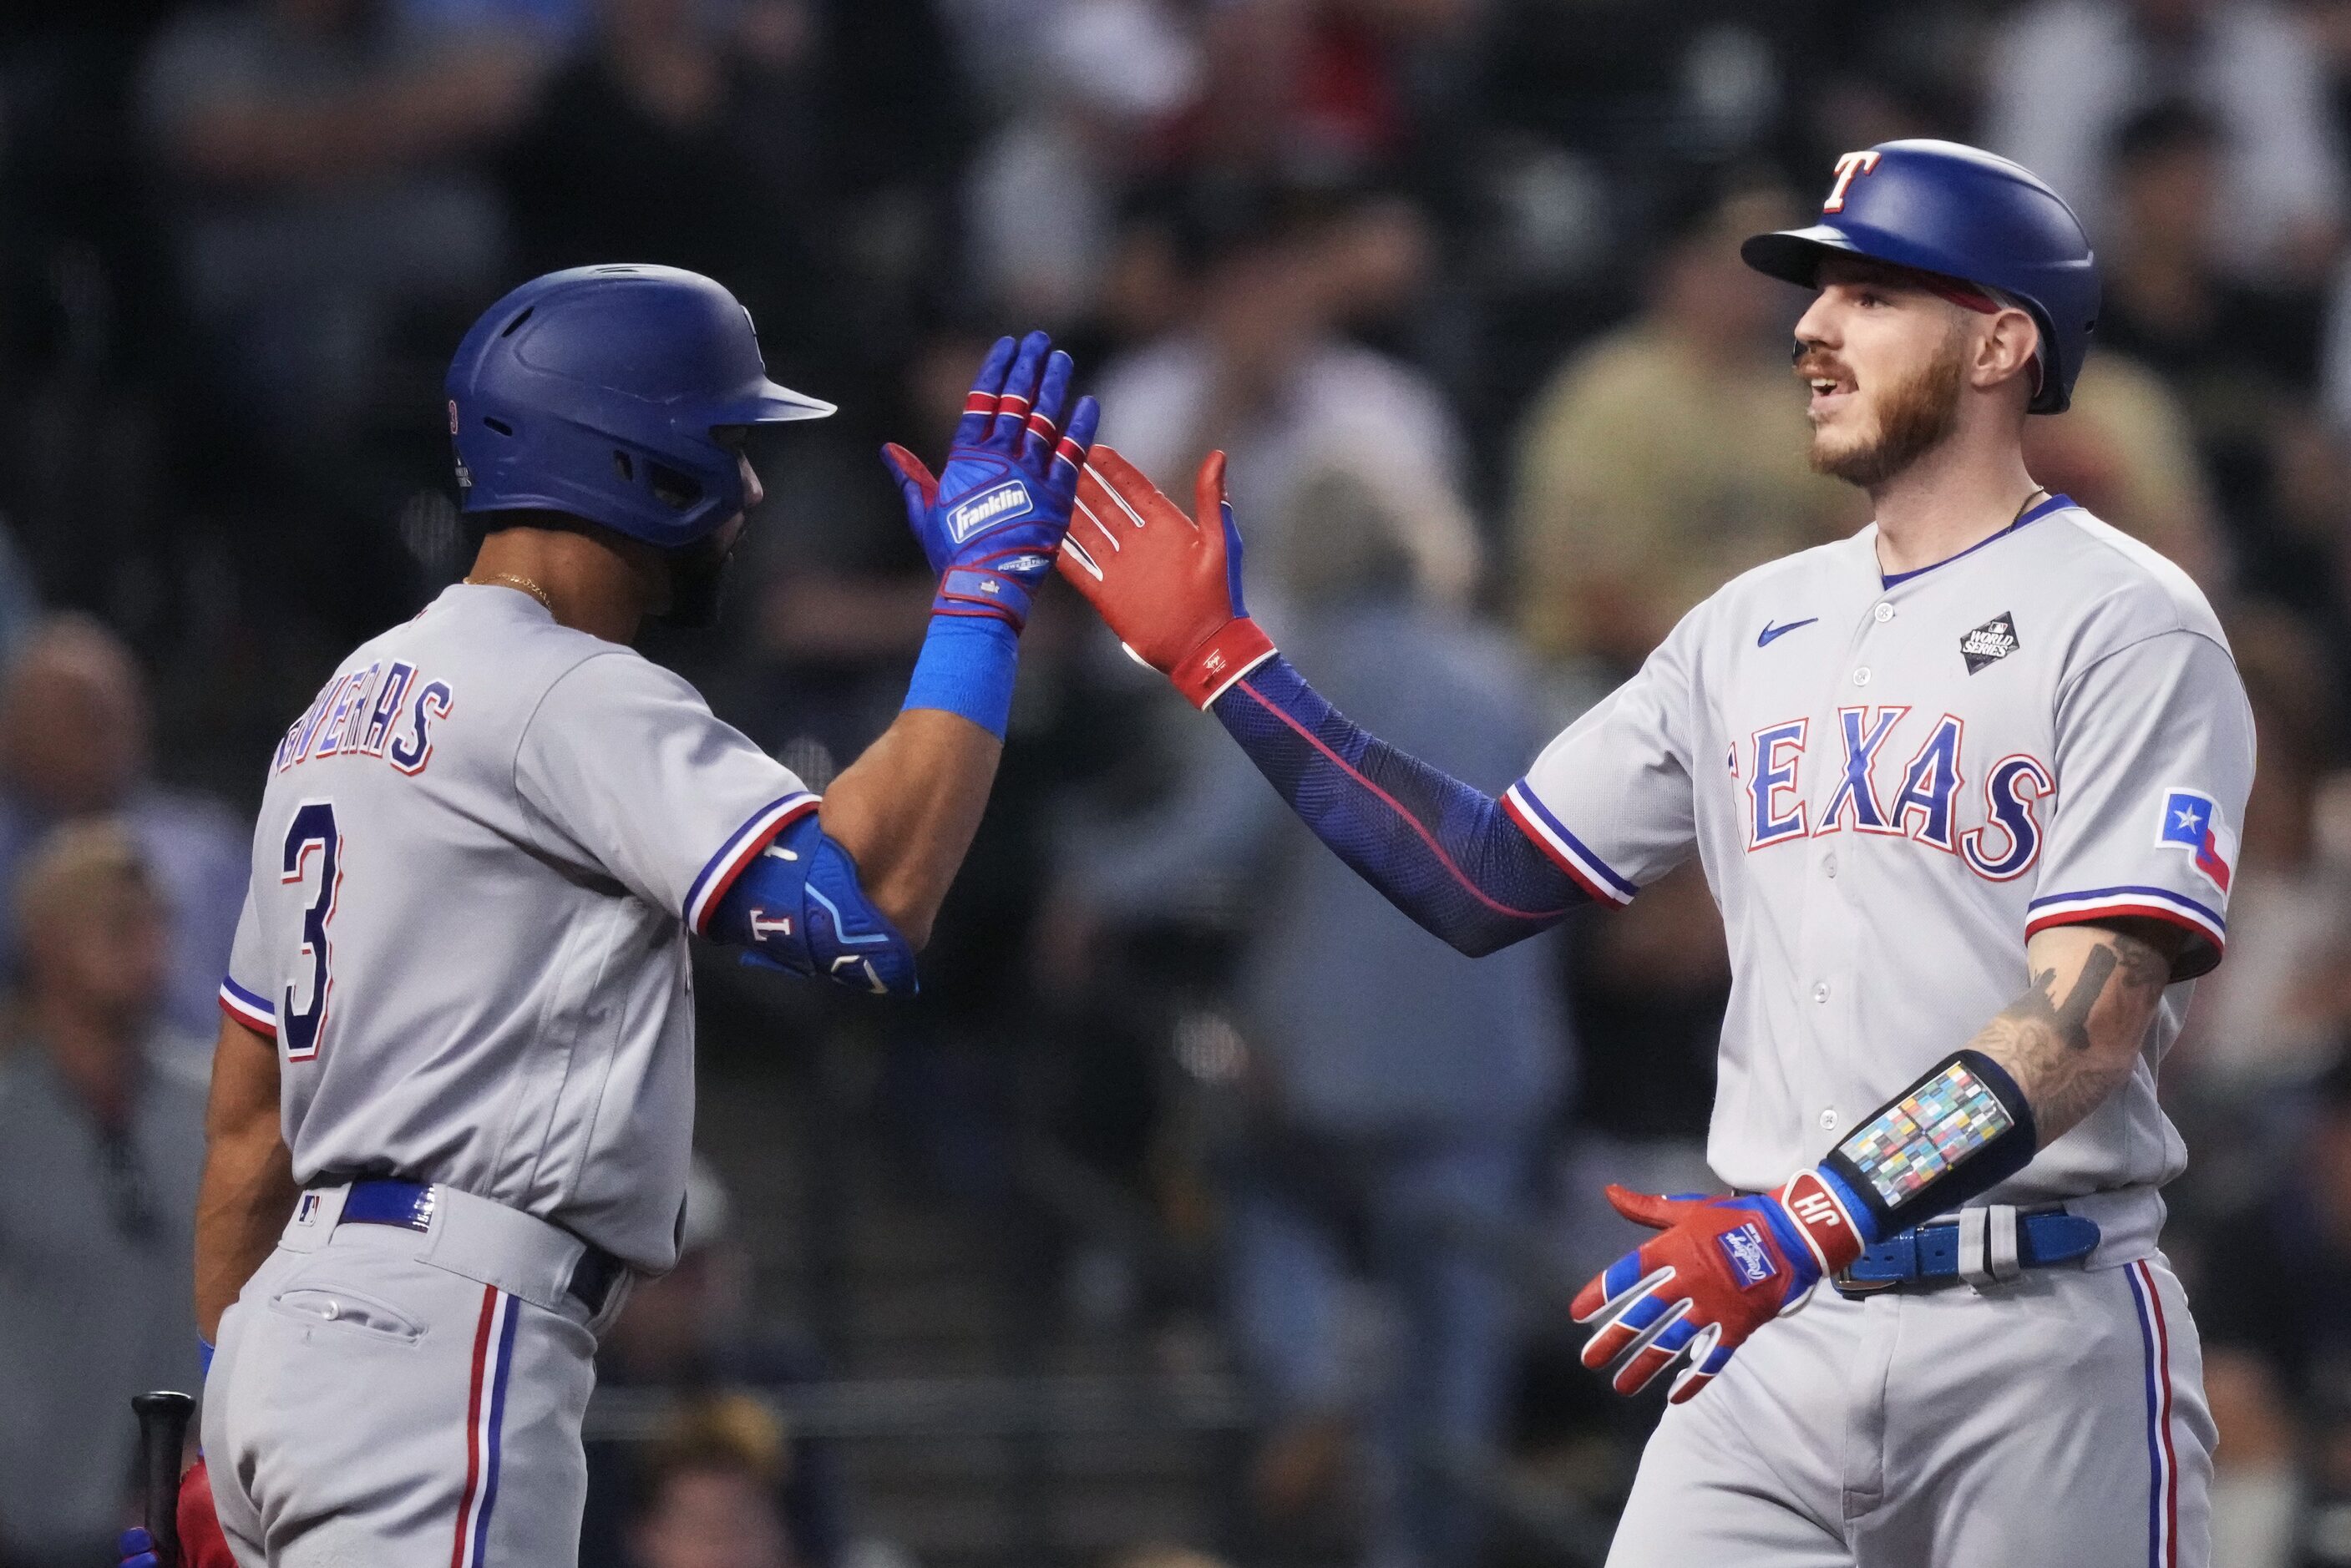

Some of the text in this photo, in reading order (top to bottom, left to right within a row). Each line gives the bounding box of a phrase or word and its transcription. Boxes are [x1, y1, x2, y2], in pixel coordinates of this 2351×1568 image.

[1823, 151, 1882, 214] T
[955, 489, 1026, 539] Franklin
[1963, 640, 2008, 657] SERIES
[1970, 630, 2014, 646] WORLD
[1727, 706, 2055, 883] EXAS
[281, 796, 343, 1063] 3
[749, 908, 793, 942] T
[1794, 1191, 1841, 1227] JH
[1725, 1232, 1767, 1280] Rawlings
